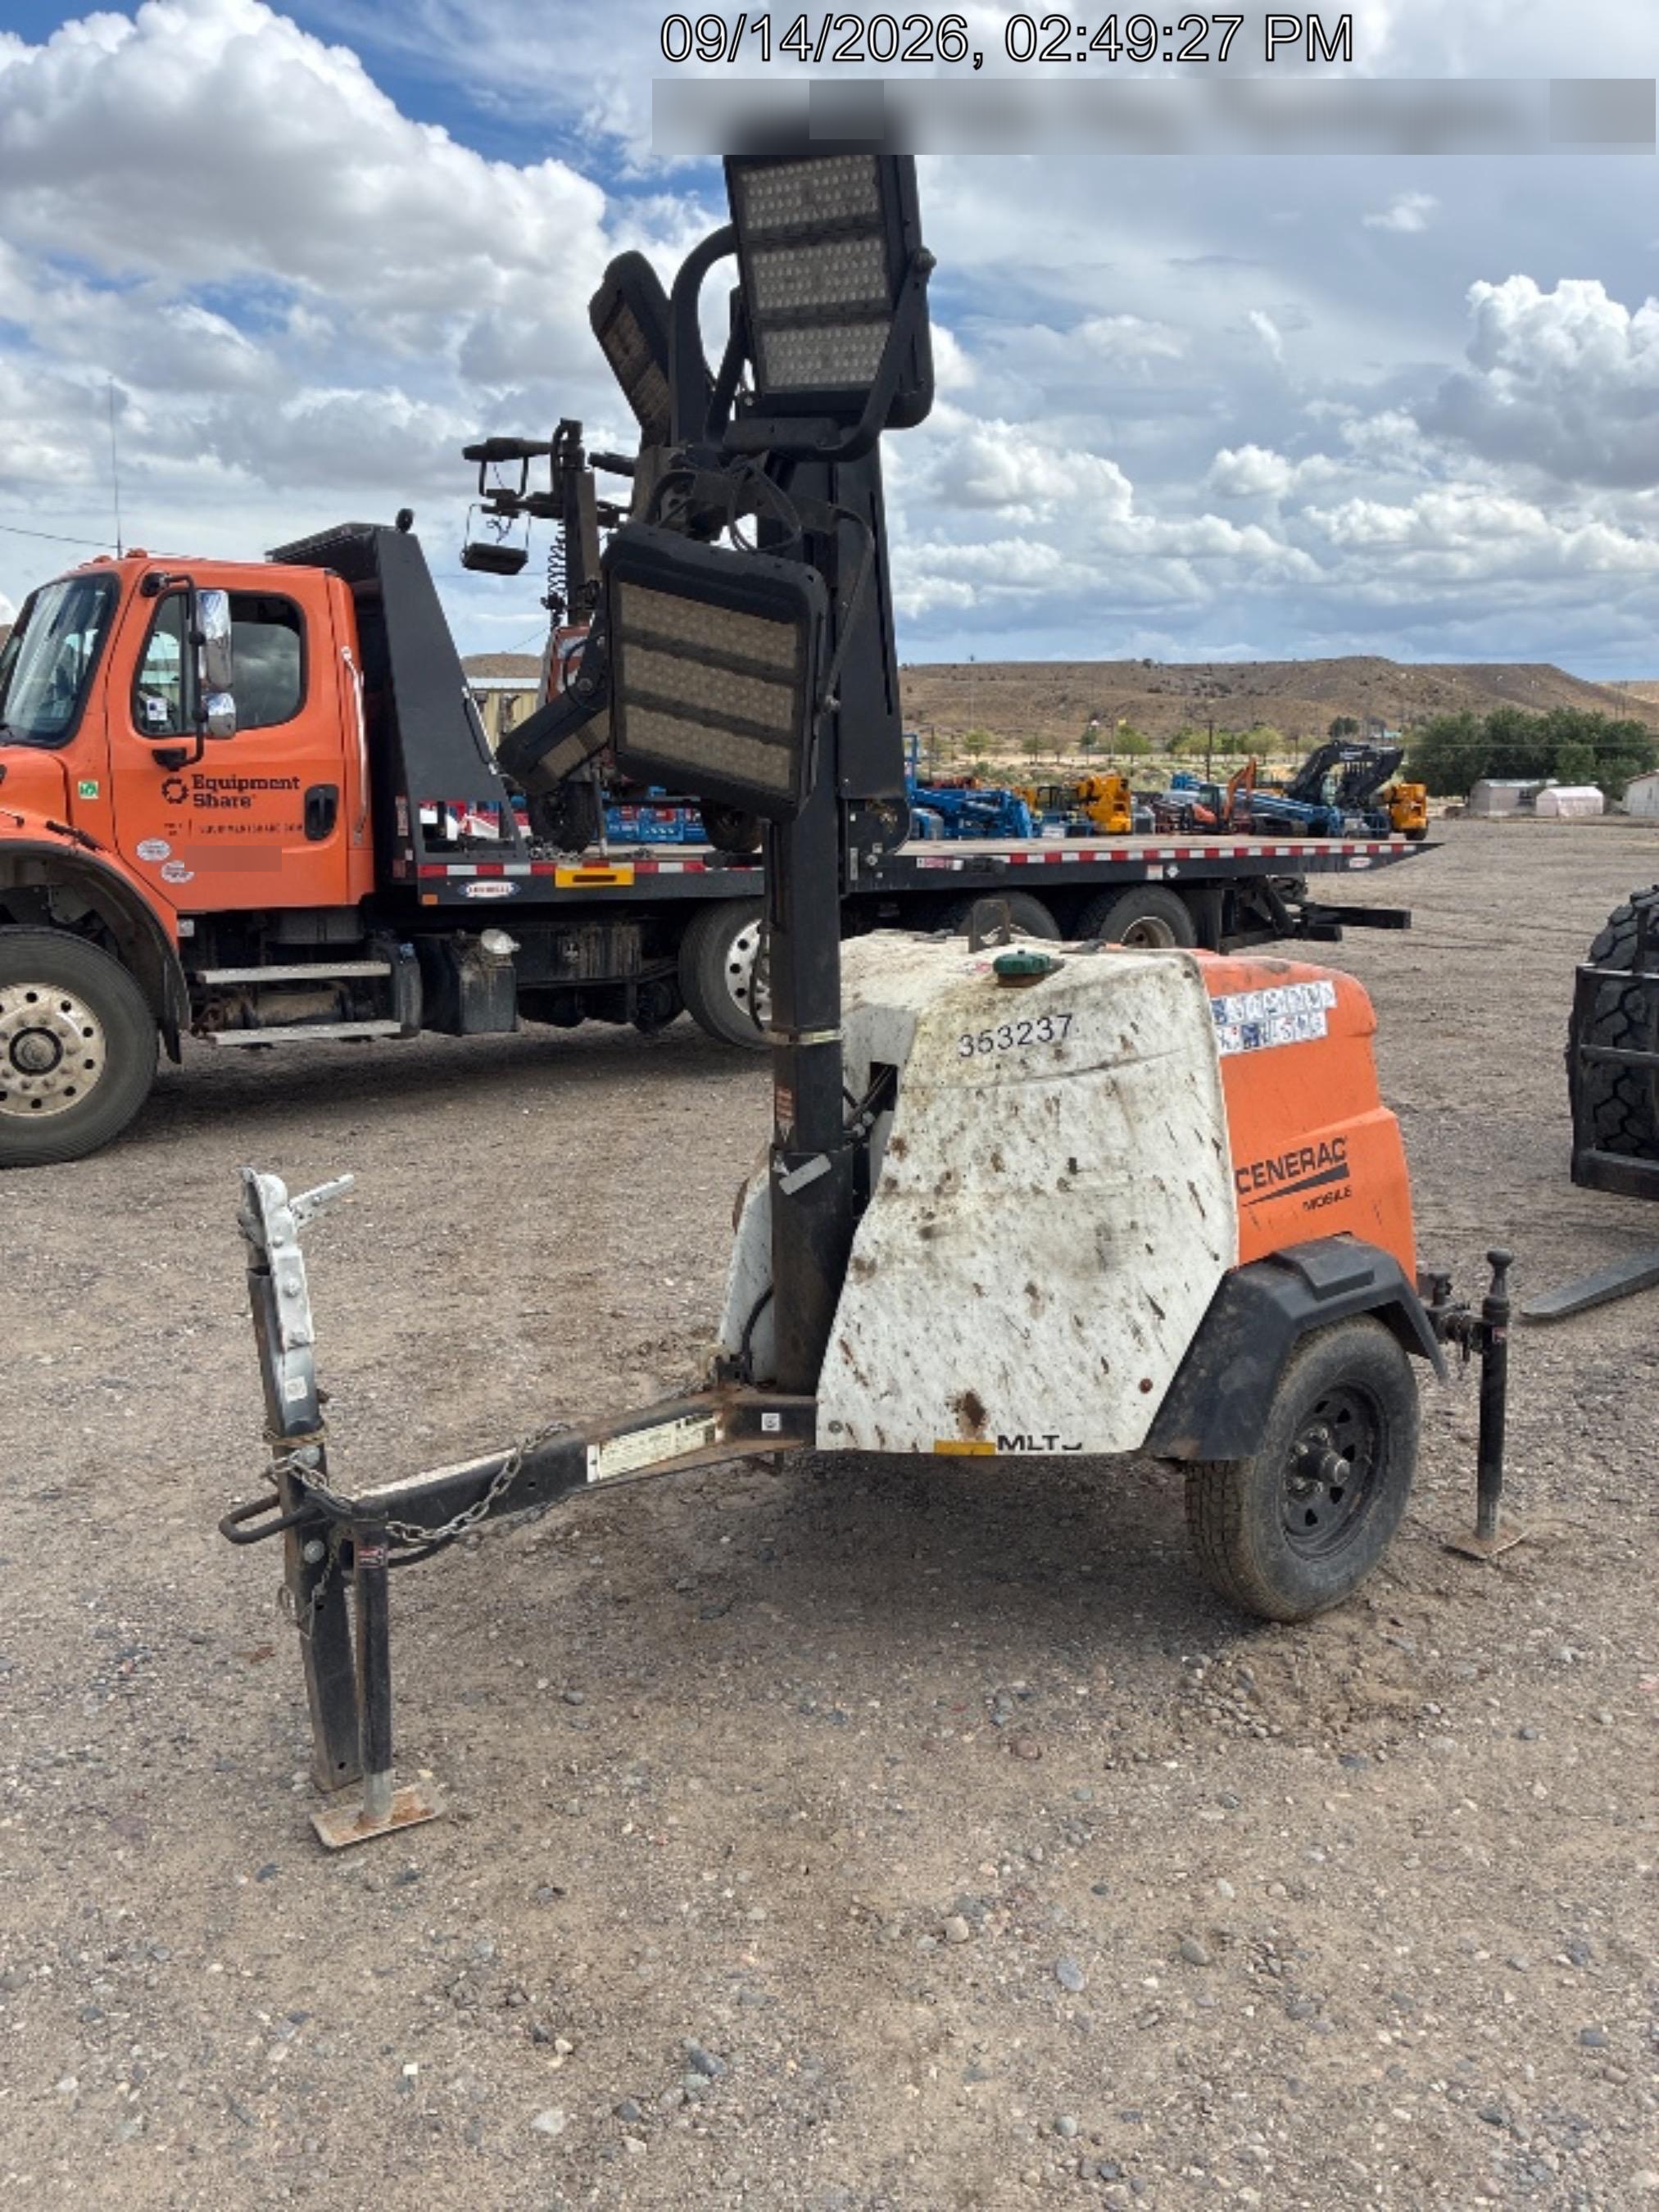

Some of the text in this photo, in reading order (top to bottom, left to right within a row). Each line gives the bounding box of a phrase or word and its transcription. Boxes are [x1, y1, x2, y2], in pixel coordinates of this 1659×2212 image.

[191, 774, 300, 792] Equipment
[193, 794, 252, 808] Share
[959, 1013, 1072, 1057] 353237
